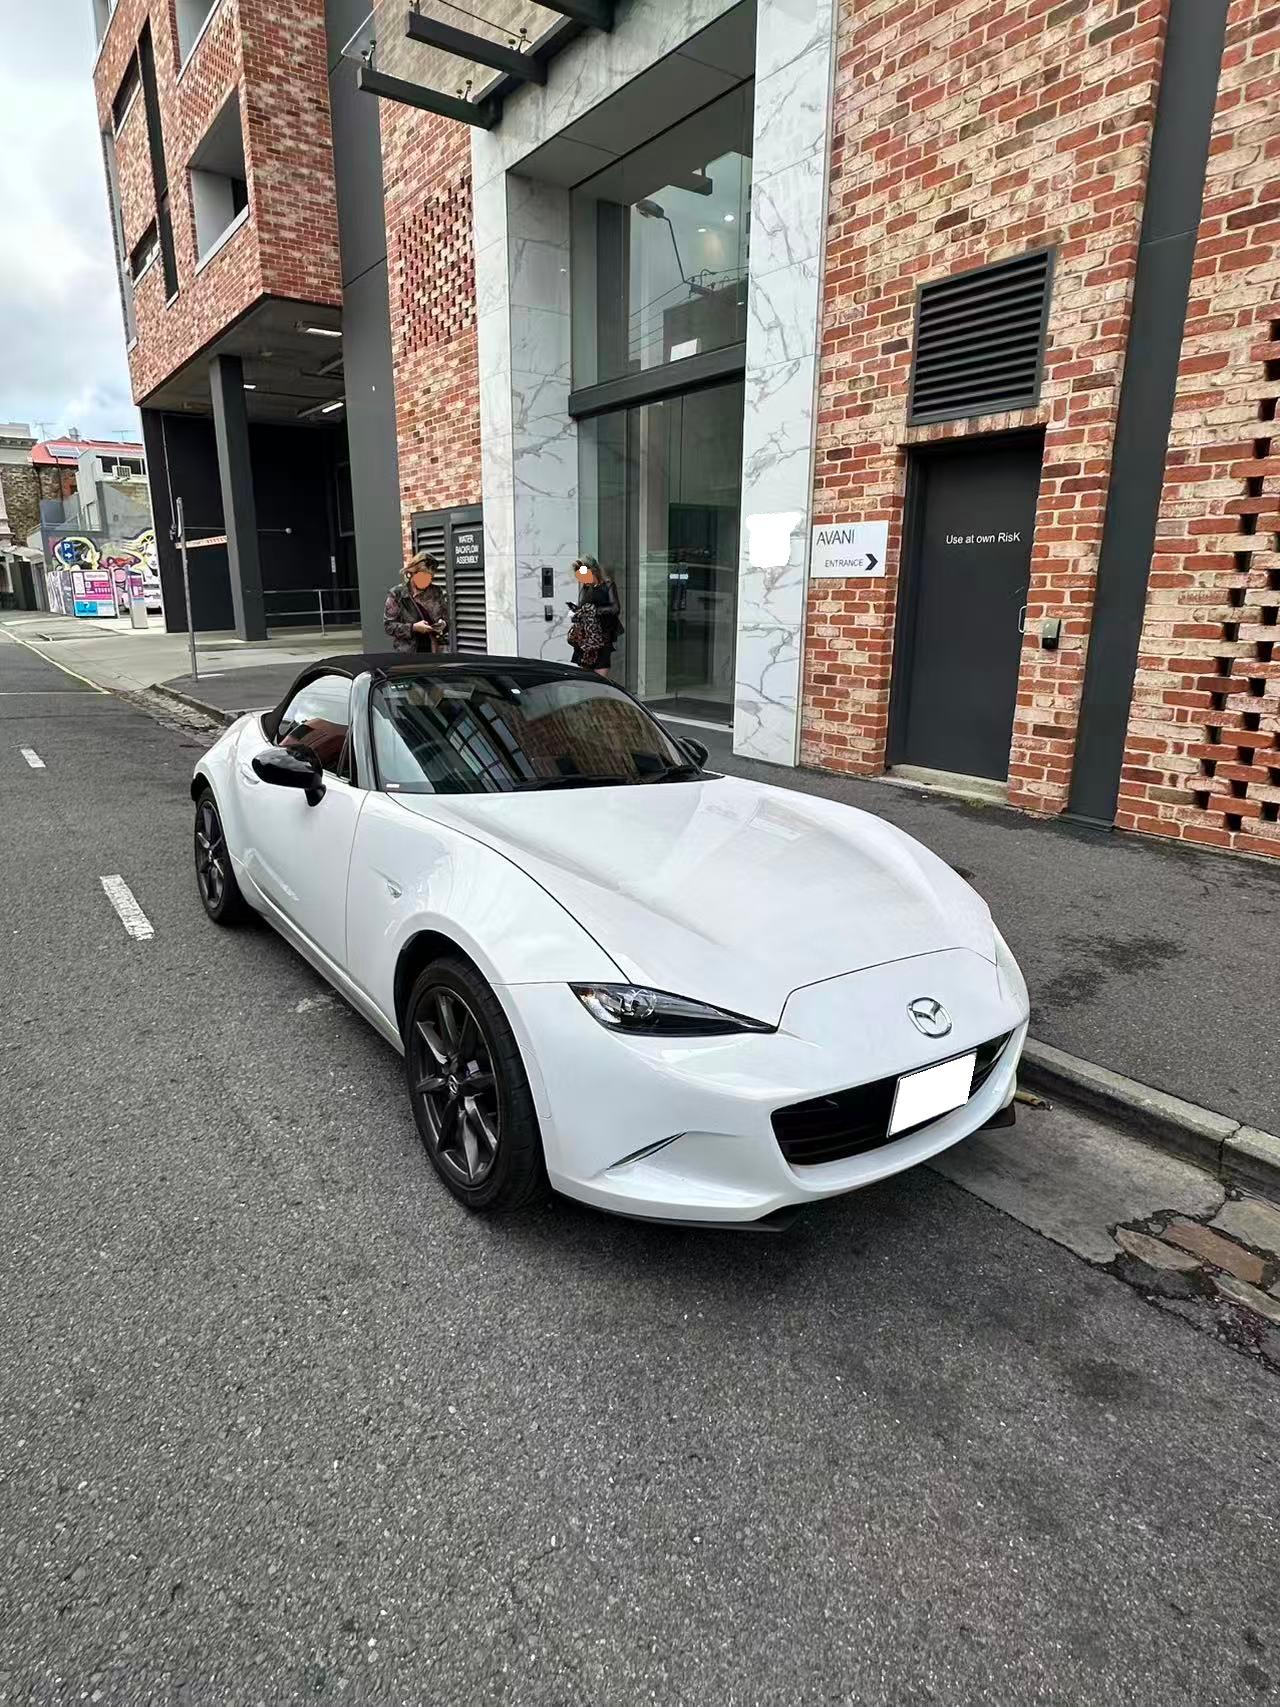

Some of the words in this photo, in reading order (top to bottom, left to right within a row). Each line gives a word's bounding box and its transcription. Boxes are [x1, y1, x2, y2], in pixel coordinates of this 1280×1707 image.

[816, 529, 855, 545] AVANI
[946, 534, 963, 544] Use
[965, 534, 975, 543] at
[976, 534, 996, 543] own
[825, 558, 864, 568] ENTRANCE
